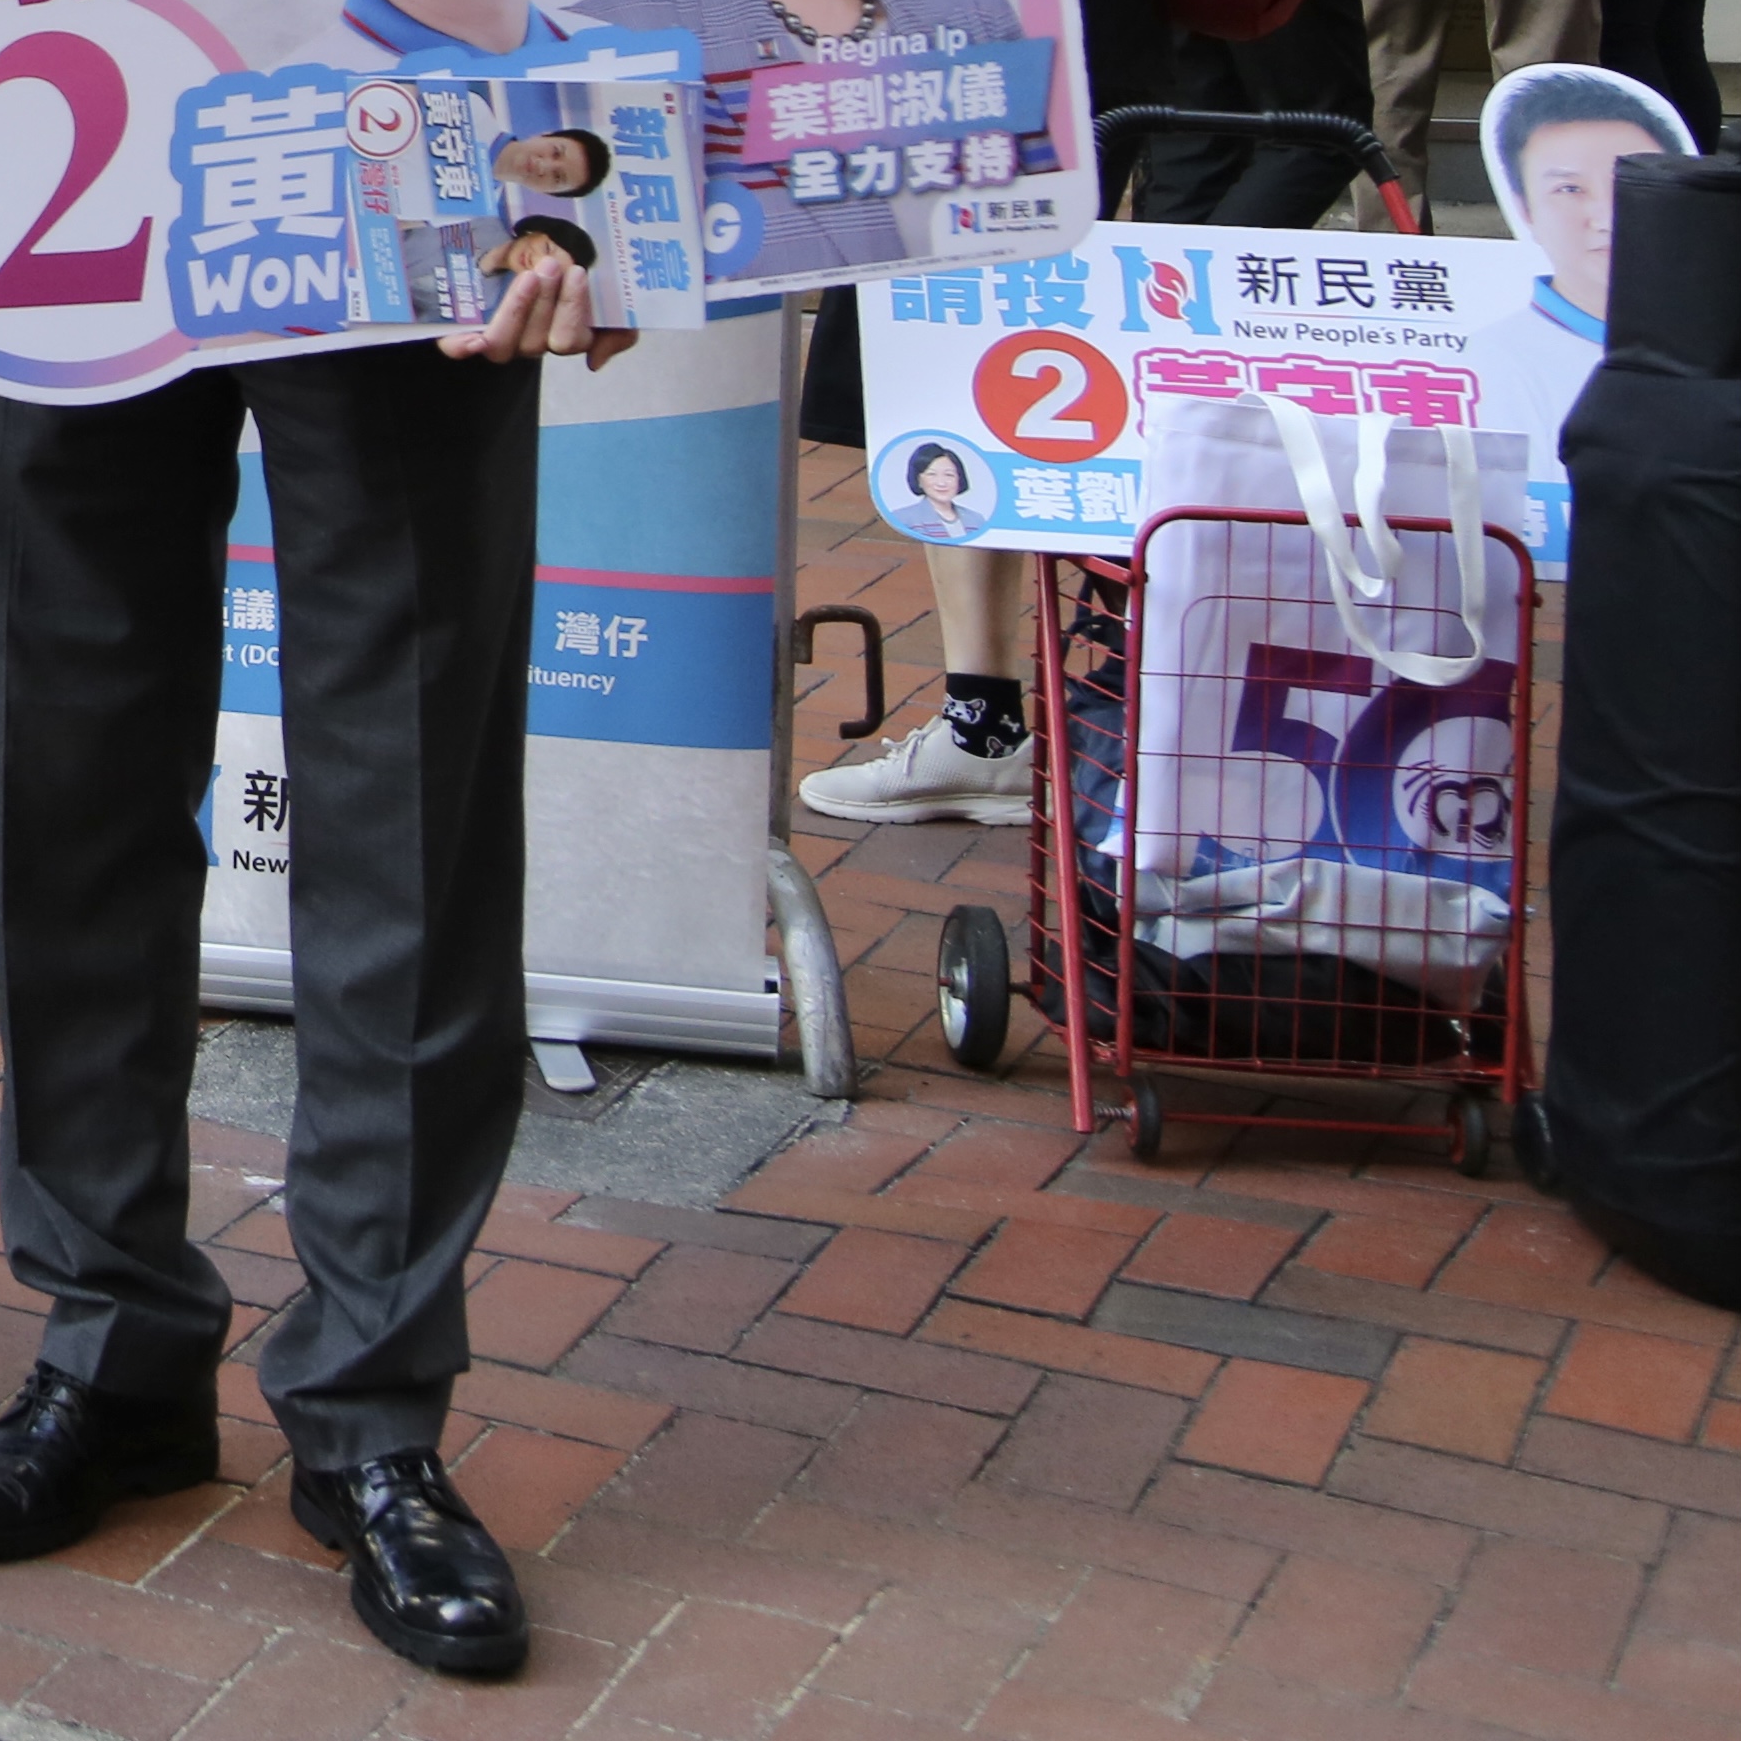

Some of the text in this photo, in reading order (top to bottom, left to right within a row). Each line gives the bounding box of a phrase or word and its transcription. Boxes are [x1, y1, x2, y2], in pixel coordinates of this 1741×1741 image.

[817, 25, 967, 68] Regina Ip
[359, 106, 402, 134] 2
[767, 64, 1008, 143] 葉劉淑儀
[422, 91, 473, 202] 黃守東
[791, 132, 1017, 203] 全力支持
[610, 105, 691, 291] 新民黨
[988, 198, 1055, 220] 新民黨
[1236, 251, 1457, 316] 新民黨
[1234, 318, 1285, 341] New
[1402, 325, 1470, 354] Party
[1013, 349, 1095, 442] 2
[554, 609, 649, 659] 灣仔
